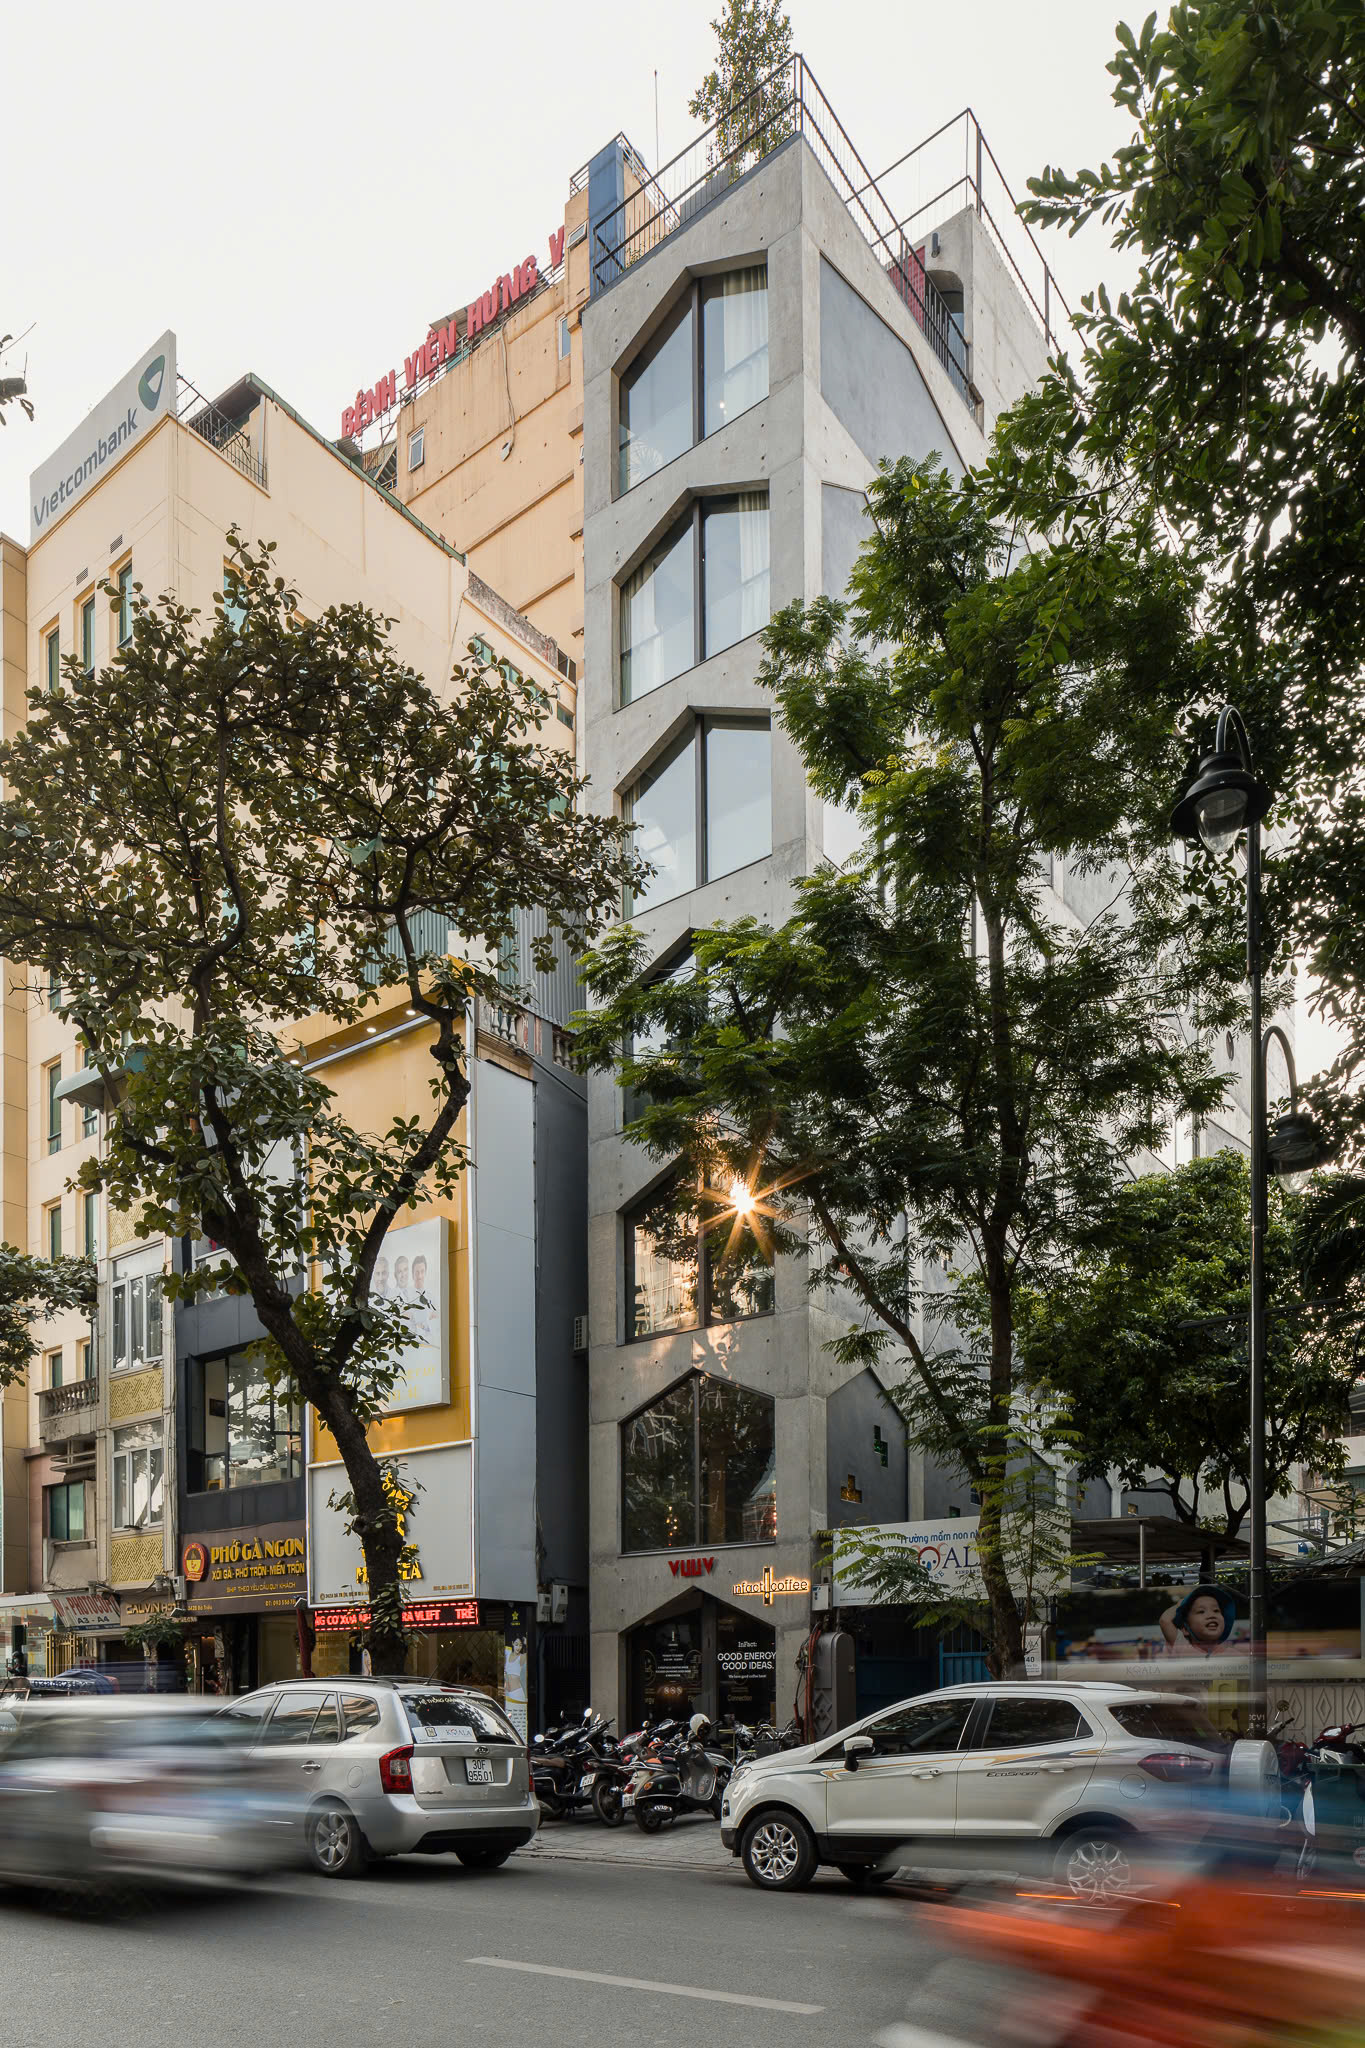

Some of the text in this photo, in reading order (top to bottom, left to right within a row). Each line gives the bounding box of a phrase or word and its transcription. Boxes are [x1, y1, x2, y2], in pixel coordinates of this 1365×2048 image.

[341, 368, 396, 438] BỆNH
[404, 319, 457, 390] VIỆN
[466, 254, 538, 340] HƯNG
[34, 408, 138, 526] Vietcombank
[953, 1531, 968, 1540] non
[242, 1536, 263, 1560] GÀ
[264, 1536, 305, 1559] NGON
[769, 1578, 808, 1593] coffee
[78, 1615, 110, 1624] A3 A4
[717, 1651, 777, 1661] GOOD ENERGY
[722, 1661, 775, 1671] GOOD IDEAS.
[472, 1759, 486, 1770] 30F
